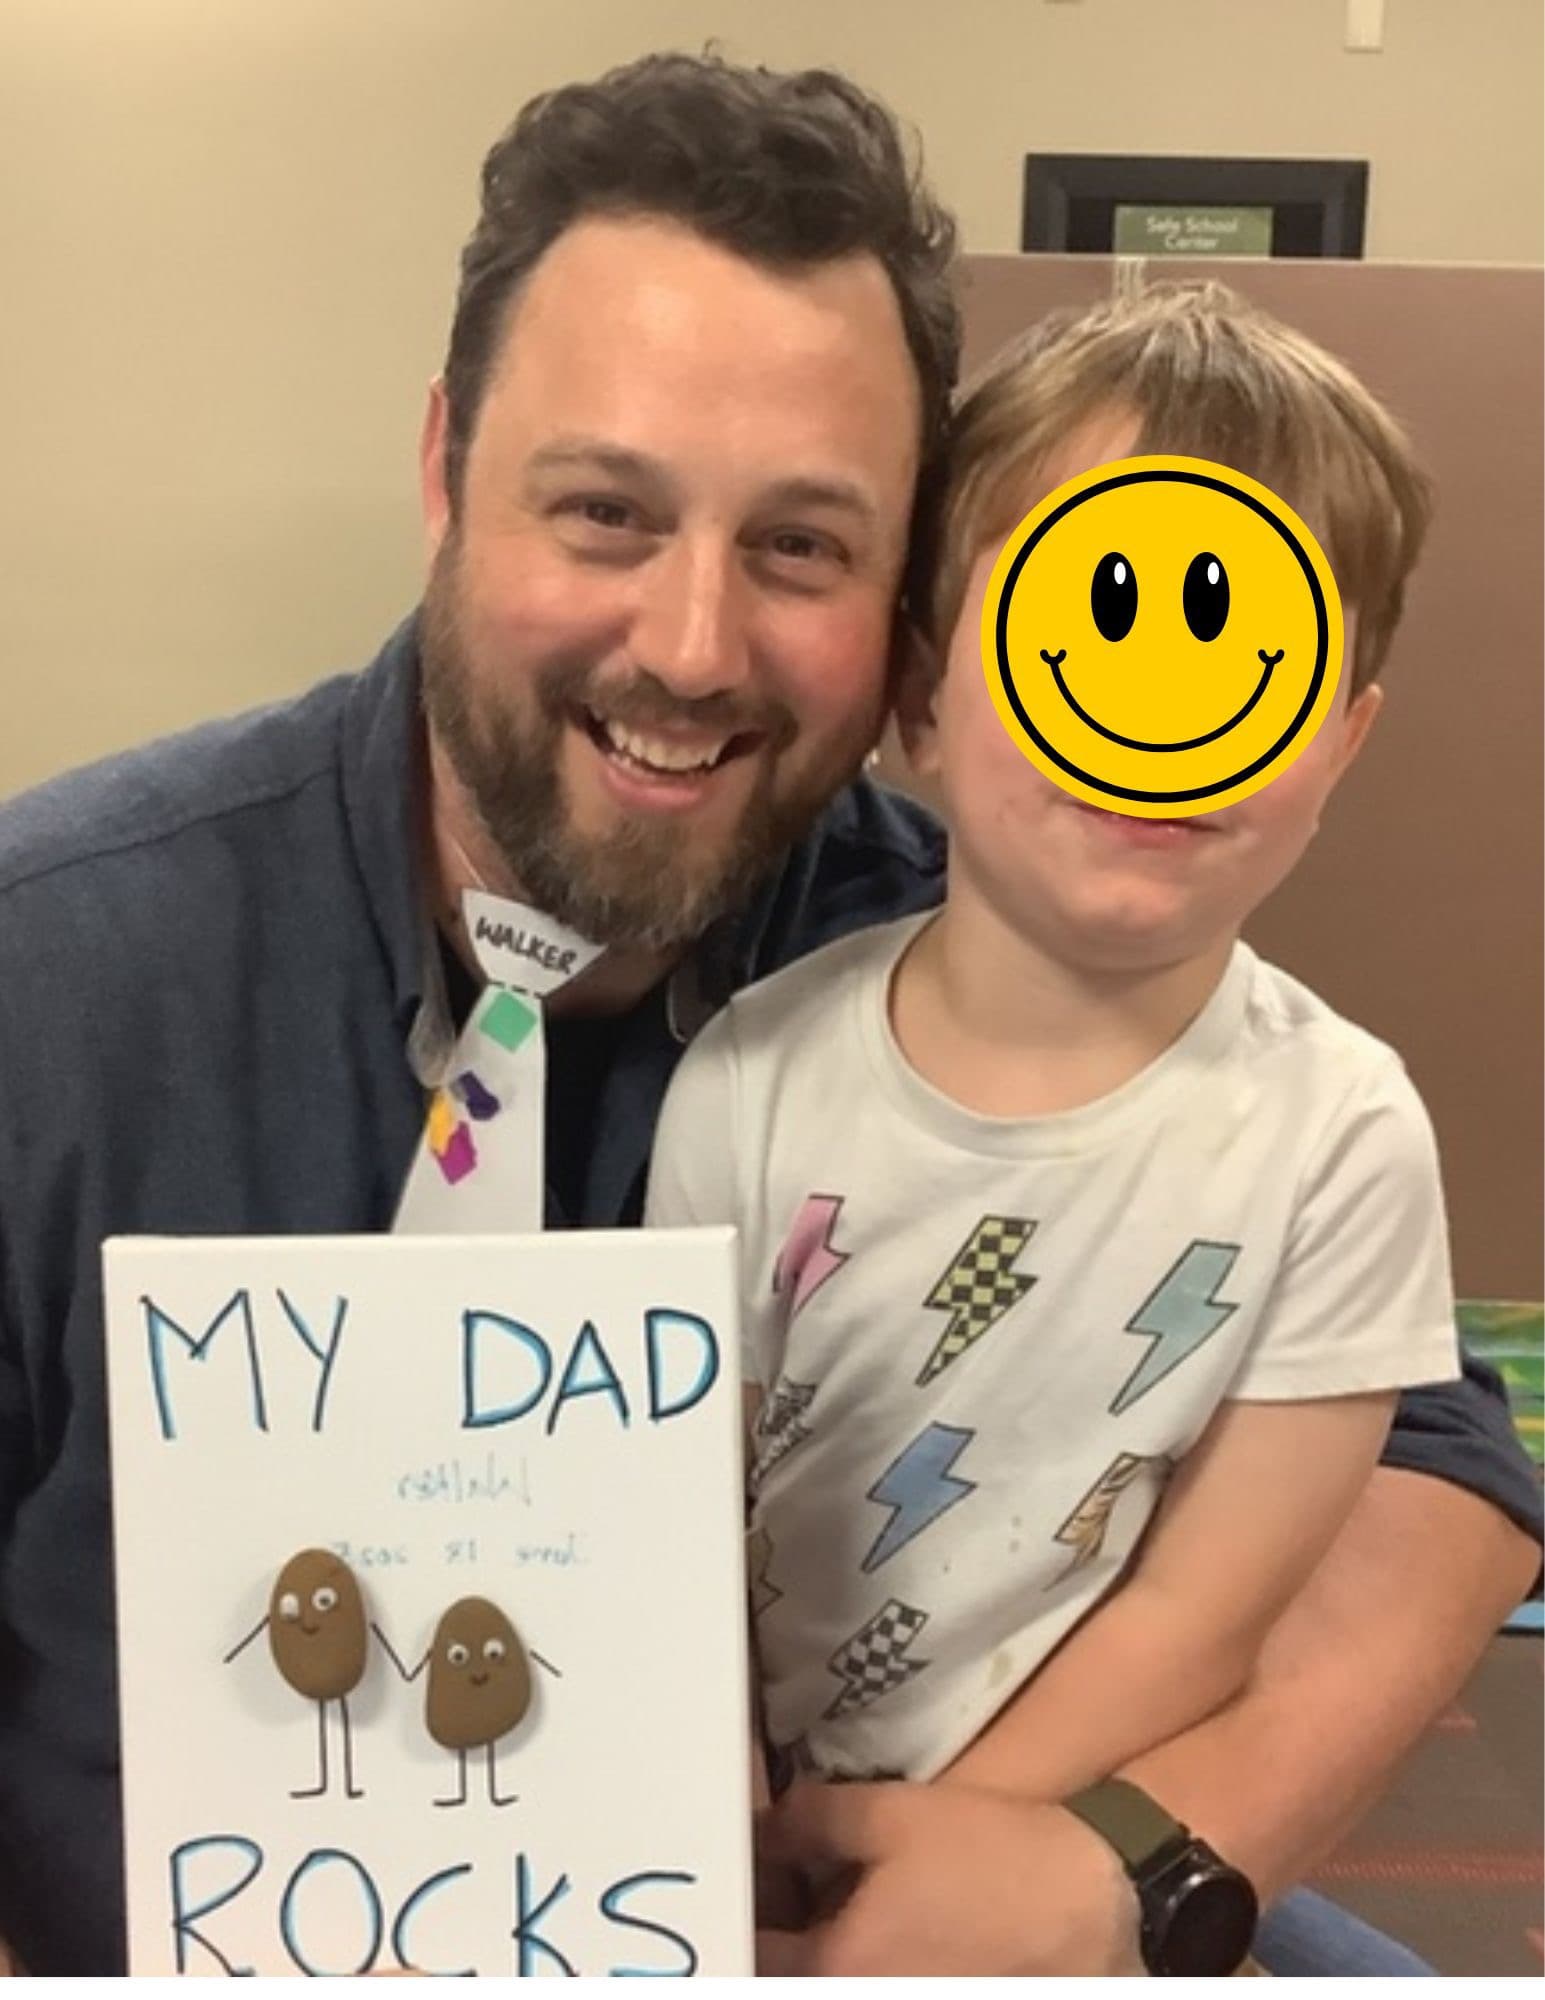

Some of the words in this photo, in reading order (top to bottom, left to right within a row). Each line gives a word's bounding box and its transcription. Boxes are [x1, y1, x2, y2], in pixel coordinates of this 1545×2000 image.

[1185, 216, 1238, 234] School
[475, 915, 578, 975] WALKER
[139, 1288, 349, 1439] MY
[462, 1307, 721, 1436] DAD
[169, 1834, 699, 1976] ROCKS
